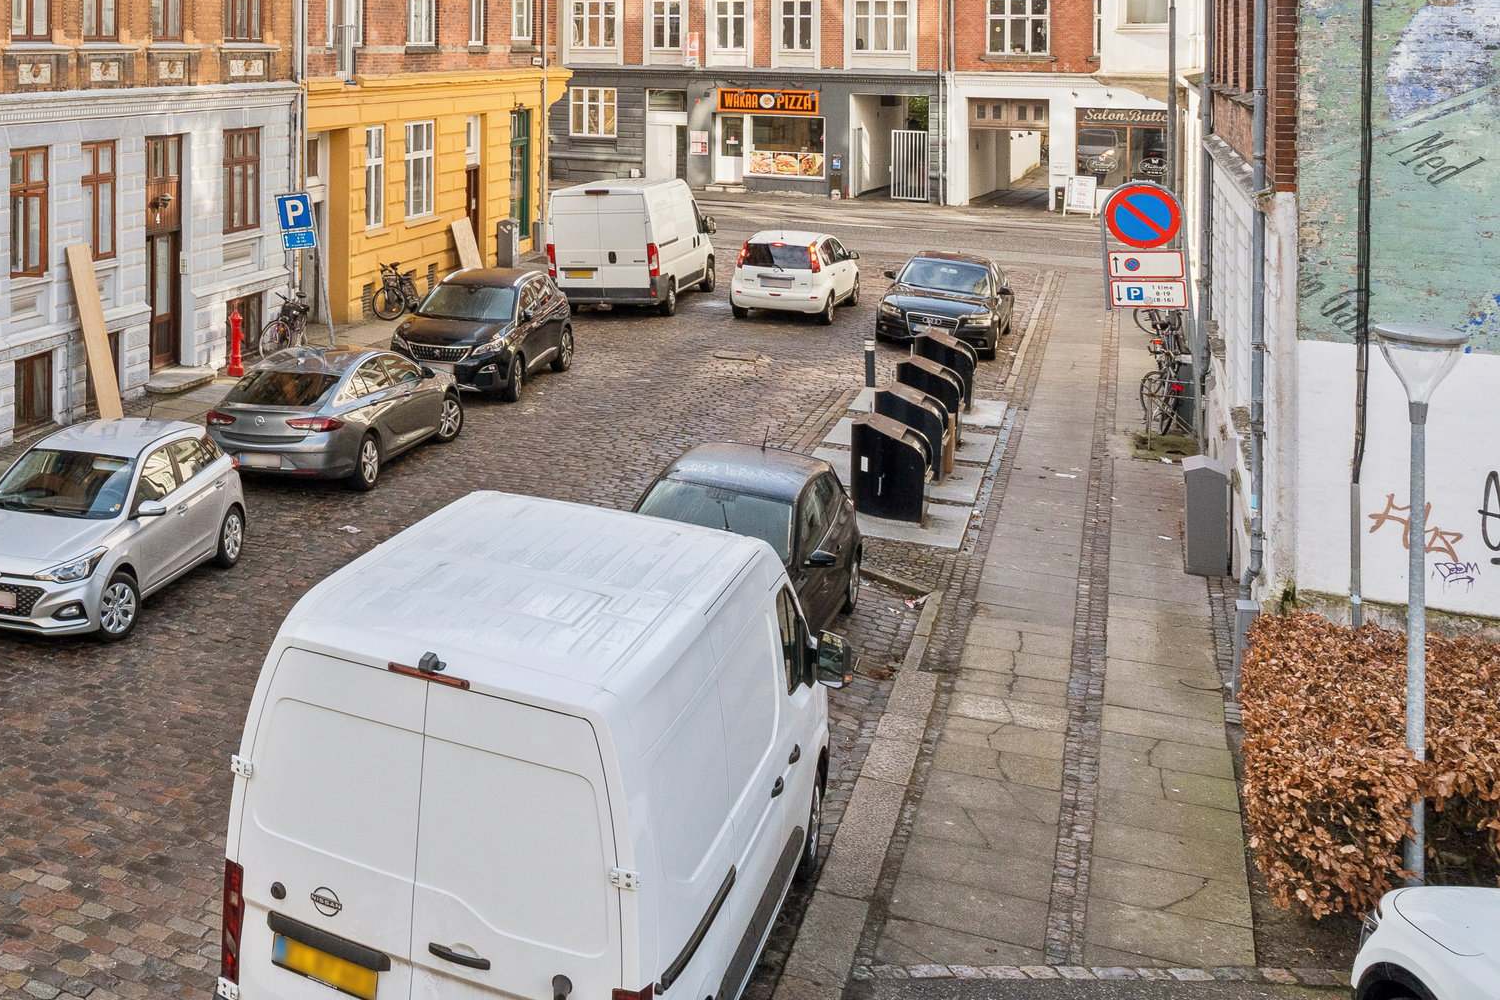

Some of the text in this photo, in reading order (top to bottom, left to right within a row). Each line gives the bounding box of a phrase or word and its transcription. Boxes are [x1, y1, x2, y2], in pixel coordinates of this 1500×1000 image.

[724, 92, 812, 110] WAKAA PIZZA
[1084, 108, 1168, 122] Salon Butte
[1385, 130, 1486, 188] Med
[285, 199, 304, 226] P
[1130, 288, 1140, 299] P
[310, 893, 342, 910] NISSAN
